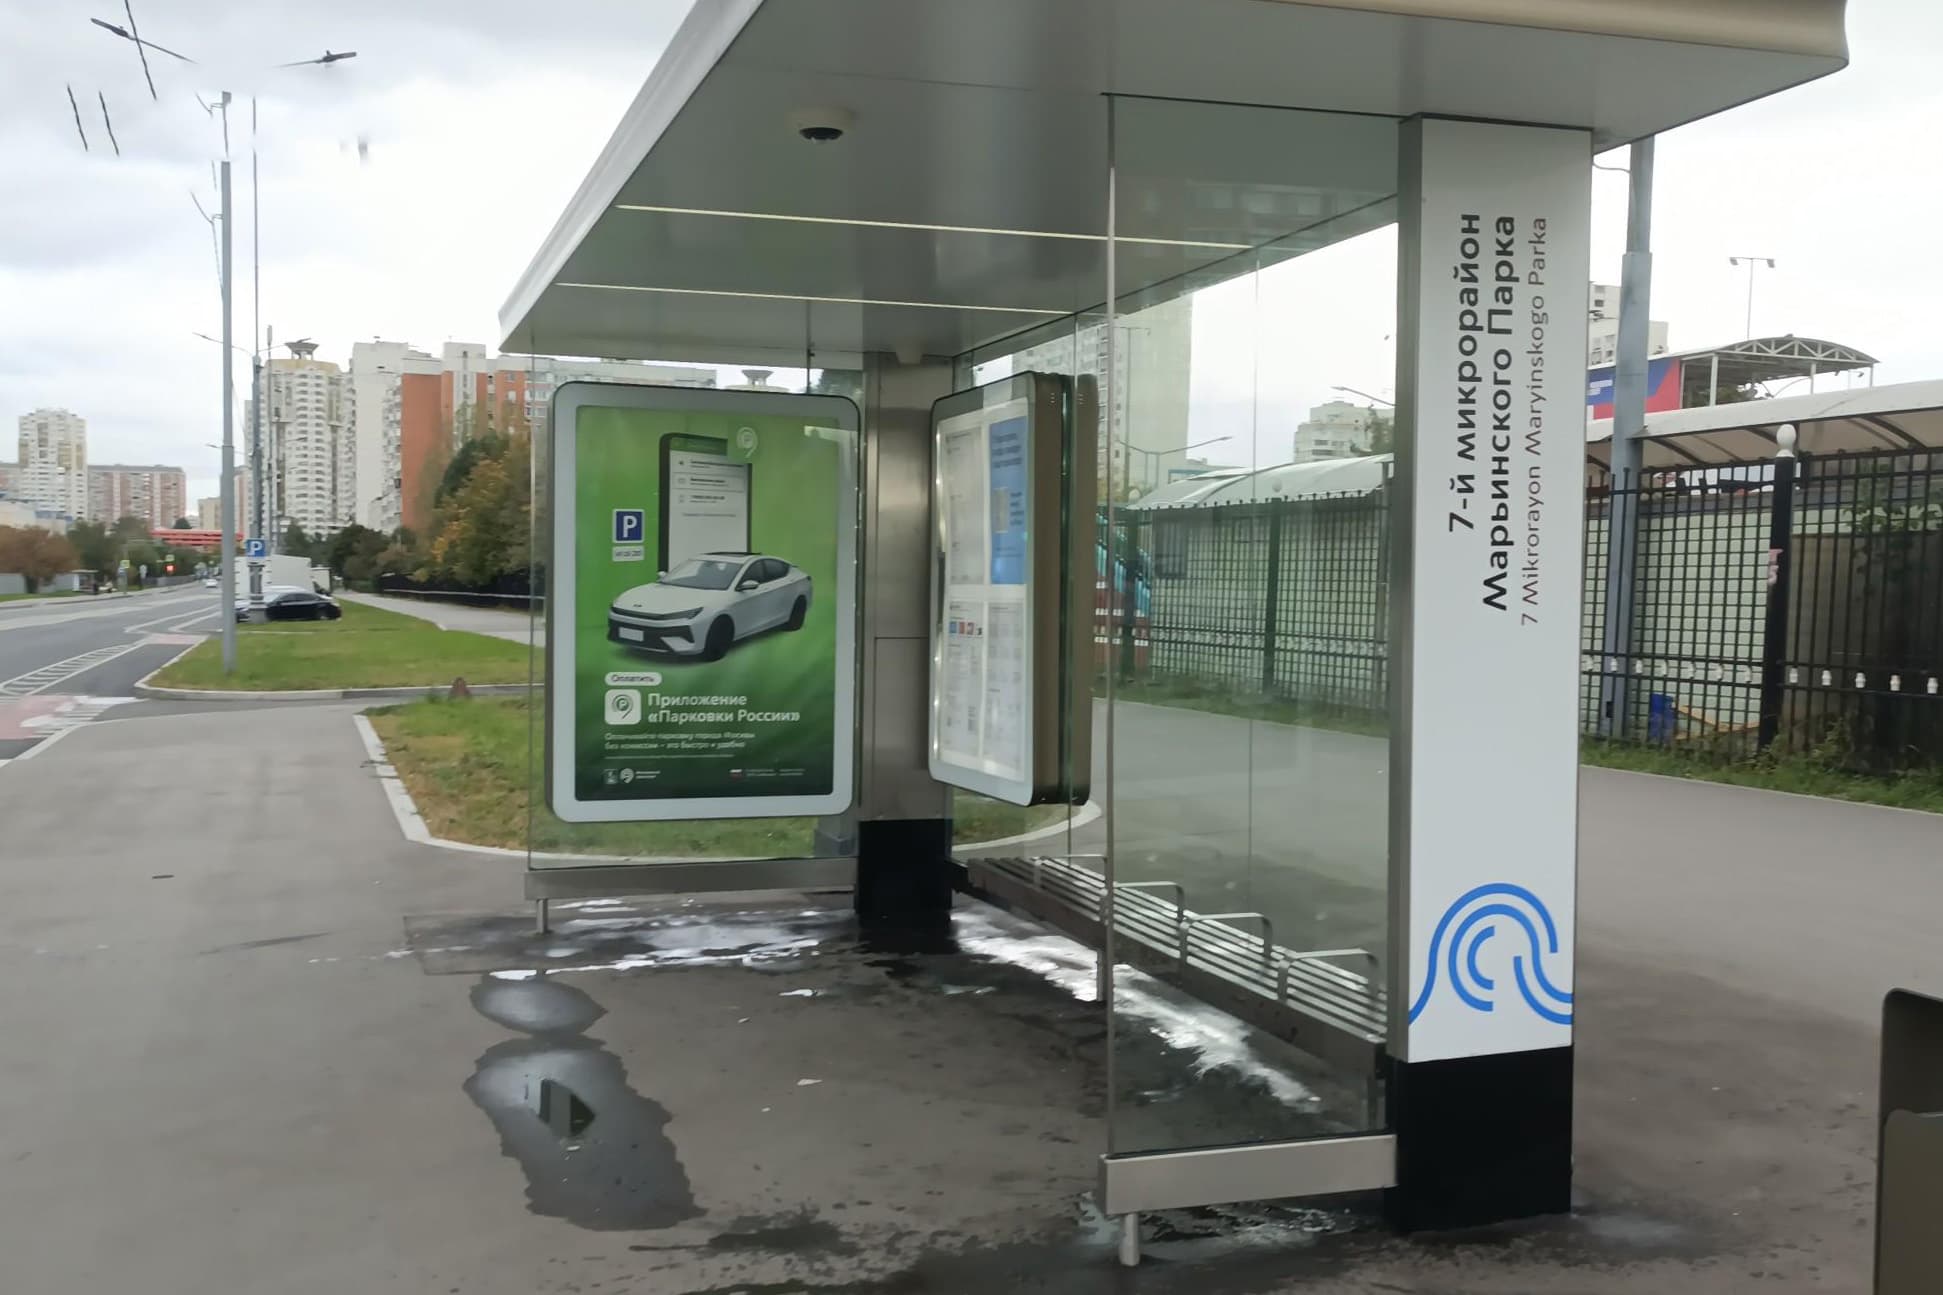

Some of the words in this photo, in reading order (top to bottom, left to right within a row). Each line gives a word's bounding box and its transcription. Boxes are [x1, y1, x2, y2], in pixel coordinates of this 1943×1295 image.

[1487, 216, 1520, 335] Парка
[1528, 217, 1547, 286] Parka
[1453, 214, 1484, 461] микрорайон
[1525, 295, 1549, 456] Maryinskogo
[1449, 474, 1475, 532] 7-й
[1483, 349, 1514, 611] Марьинского
[248, 540, 263, 556] P
[623, 515, 638, 538] P
[1522, 466, 1545, 606] Mikrorayon
[1521, 613, 1538, 626] 7
[647, 693, 748, 707] Приложение
[647, 710, 734, 725] «Парковки
[737, 709, 800, 722] России»
